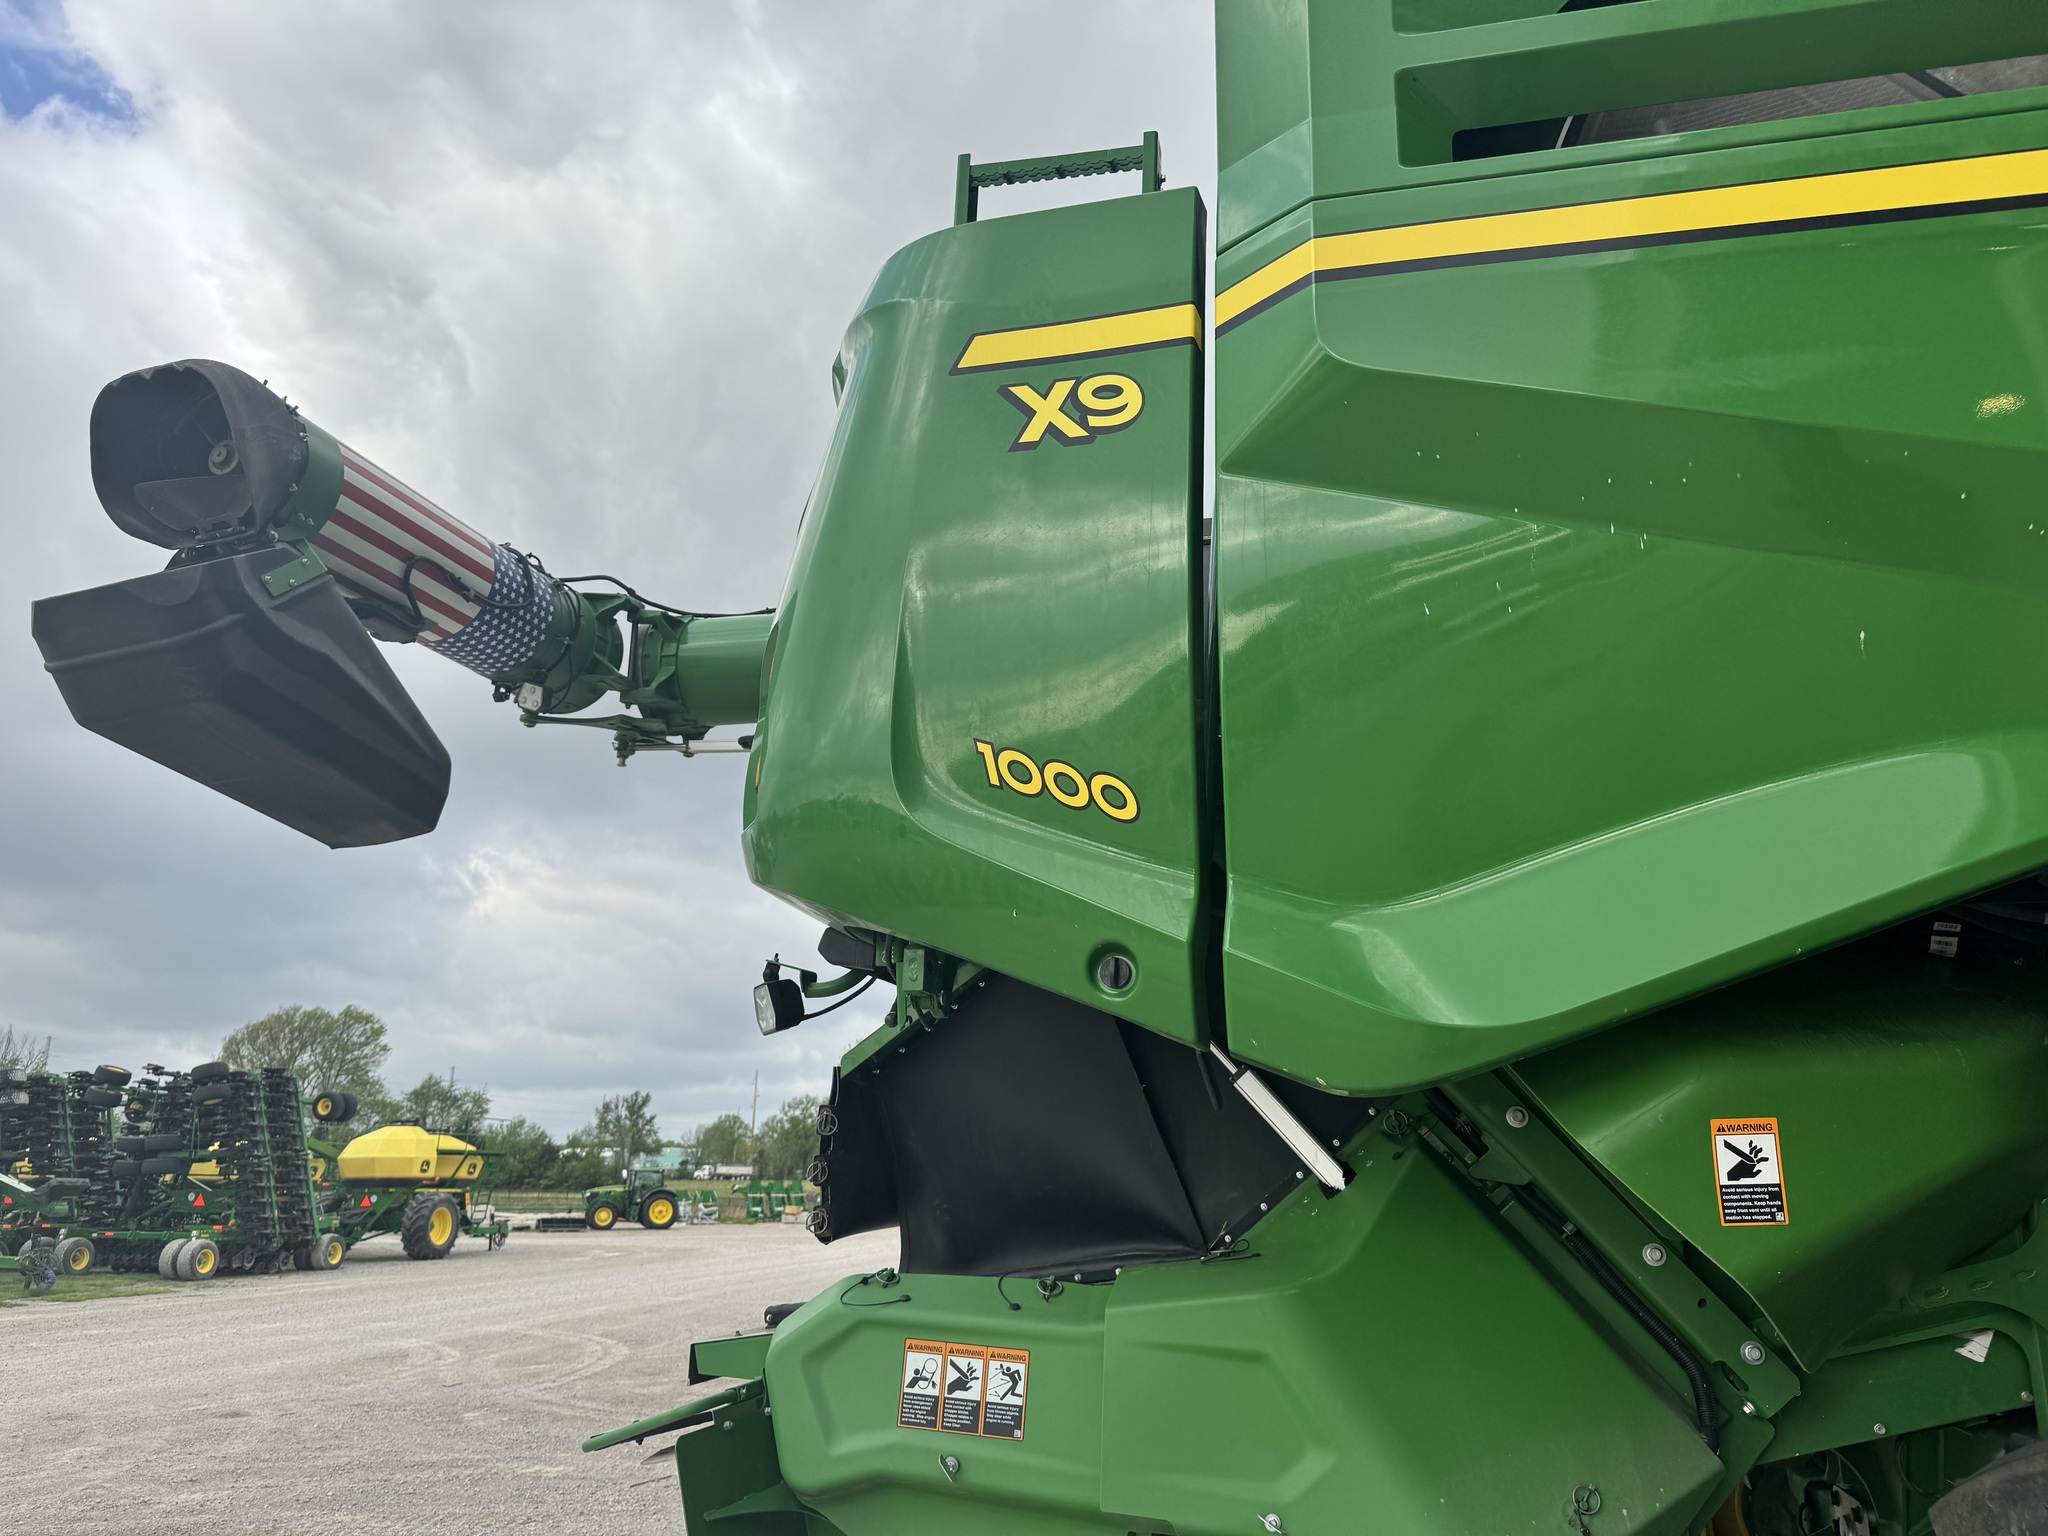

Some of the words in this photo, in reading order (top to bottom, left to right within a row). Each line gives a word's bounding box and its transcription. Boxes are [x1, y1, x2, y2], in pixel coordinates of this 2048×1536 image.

[1000, 372, 1144, 450] X9
[974, 738, 1139, 823] 1000
[1726, 1123, 1772, 1132] WARNING
[914, 1344, 942, 1352] WARNING
[955, 1348, 984, 1357] WARNING
[996, 1352, 1026, 1361] WARNING
